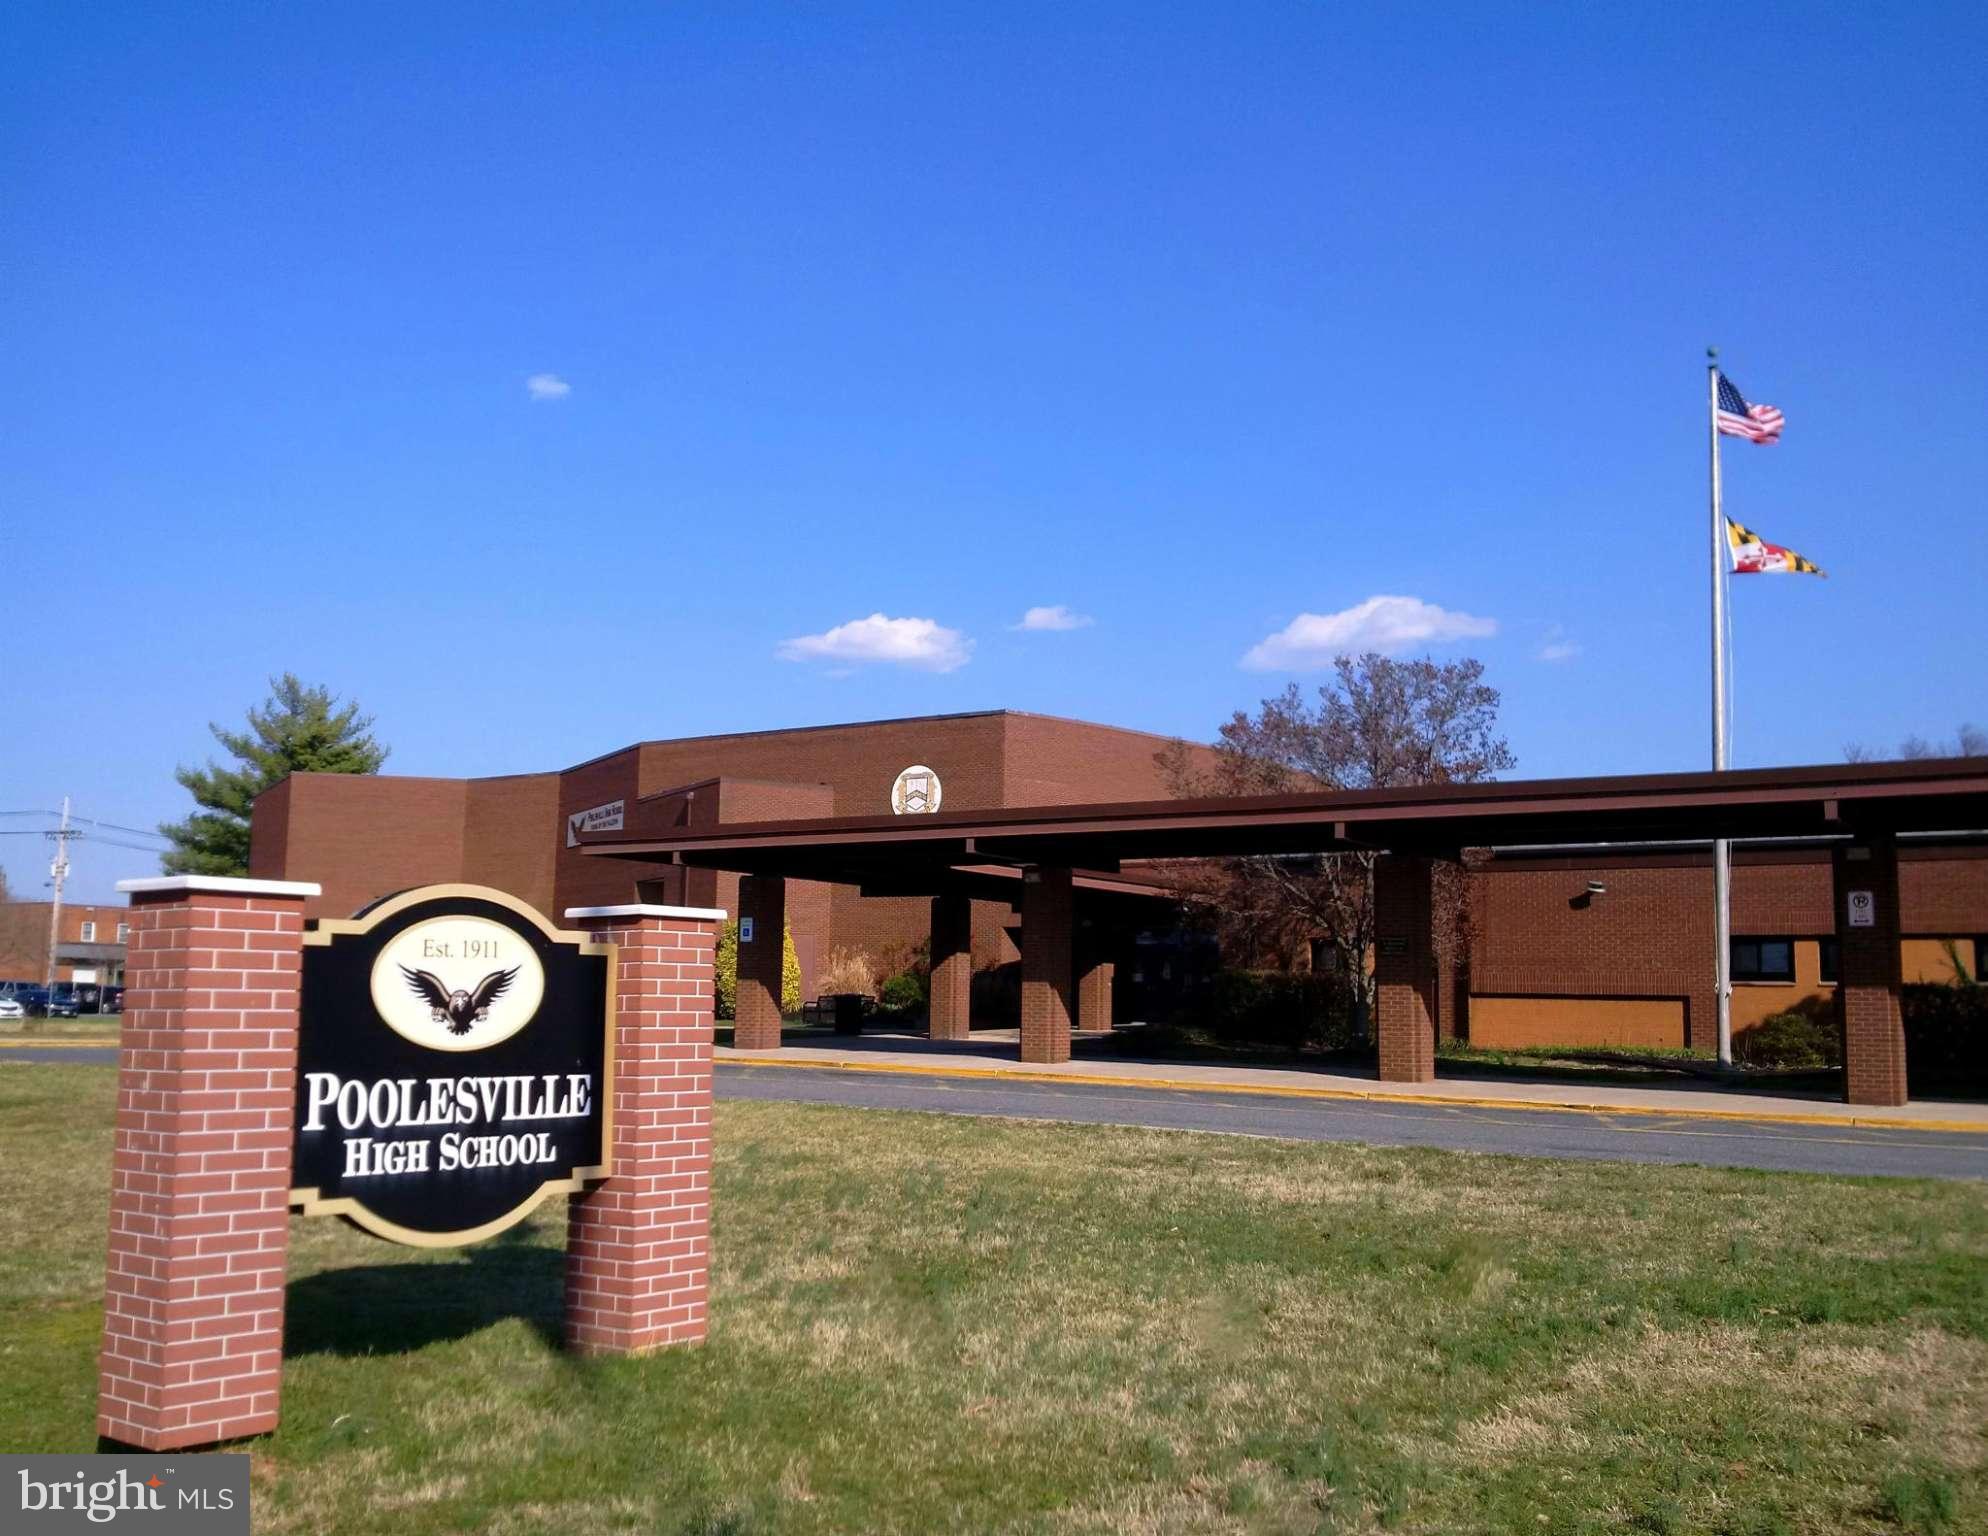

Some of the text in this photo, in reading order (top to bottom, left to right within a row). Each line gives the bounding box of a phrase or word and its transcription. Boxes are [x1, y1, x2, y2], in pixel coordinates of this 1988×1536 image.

[423, 938, 499, 960] Est. 1911
[302, 1073, 592, 1131] POOLESVILLE
[342, 1132, 557, 1178] HIGH SCHOOL
